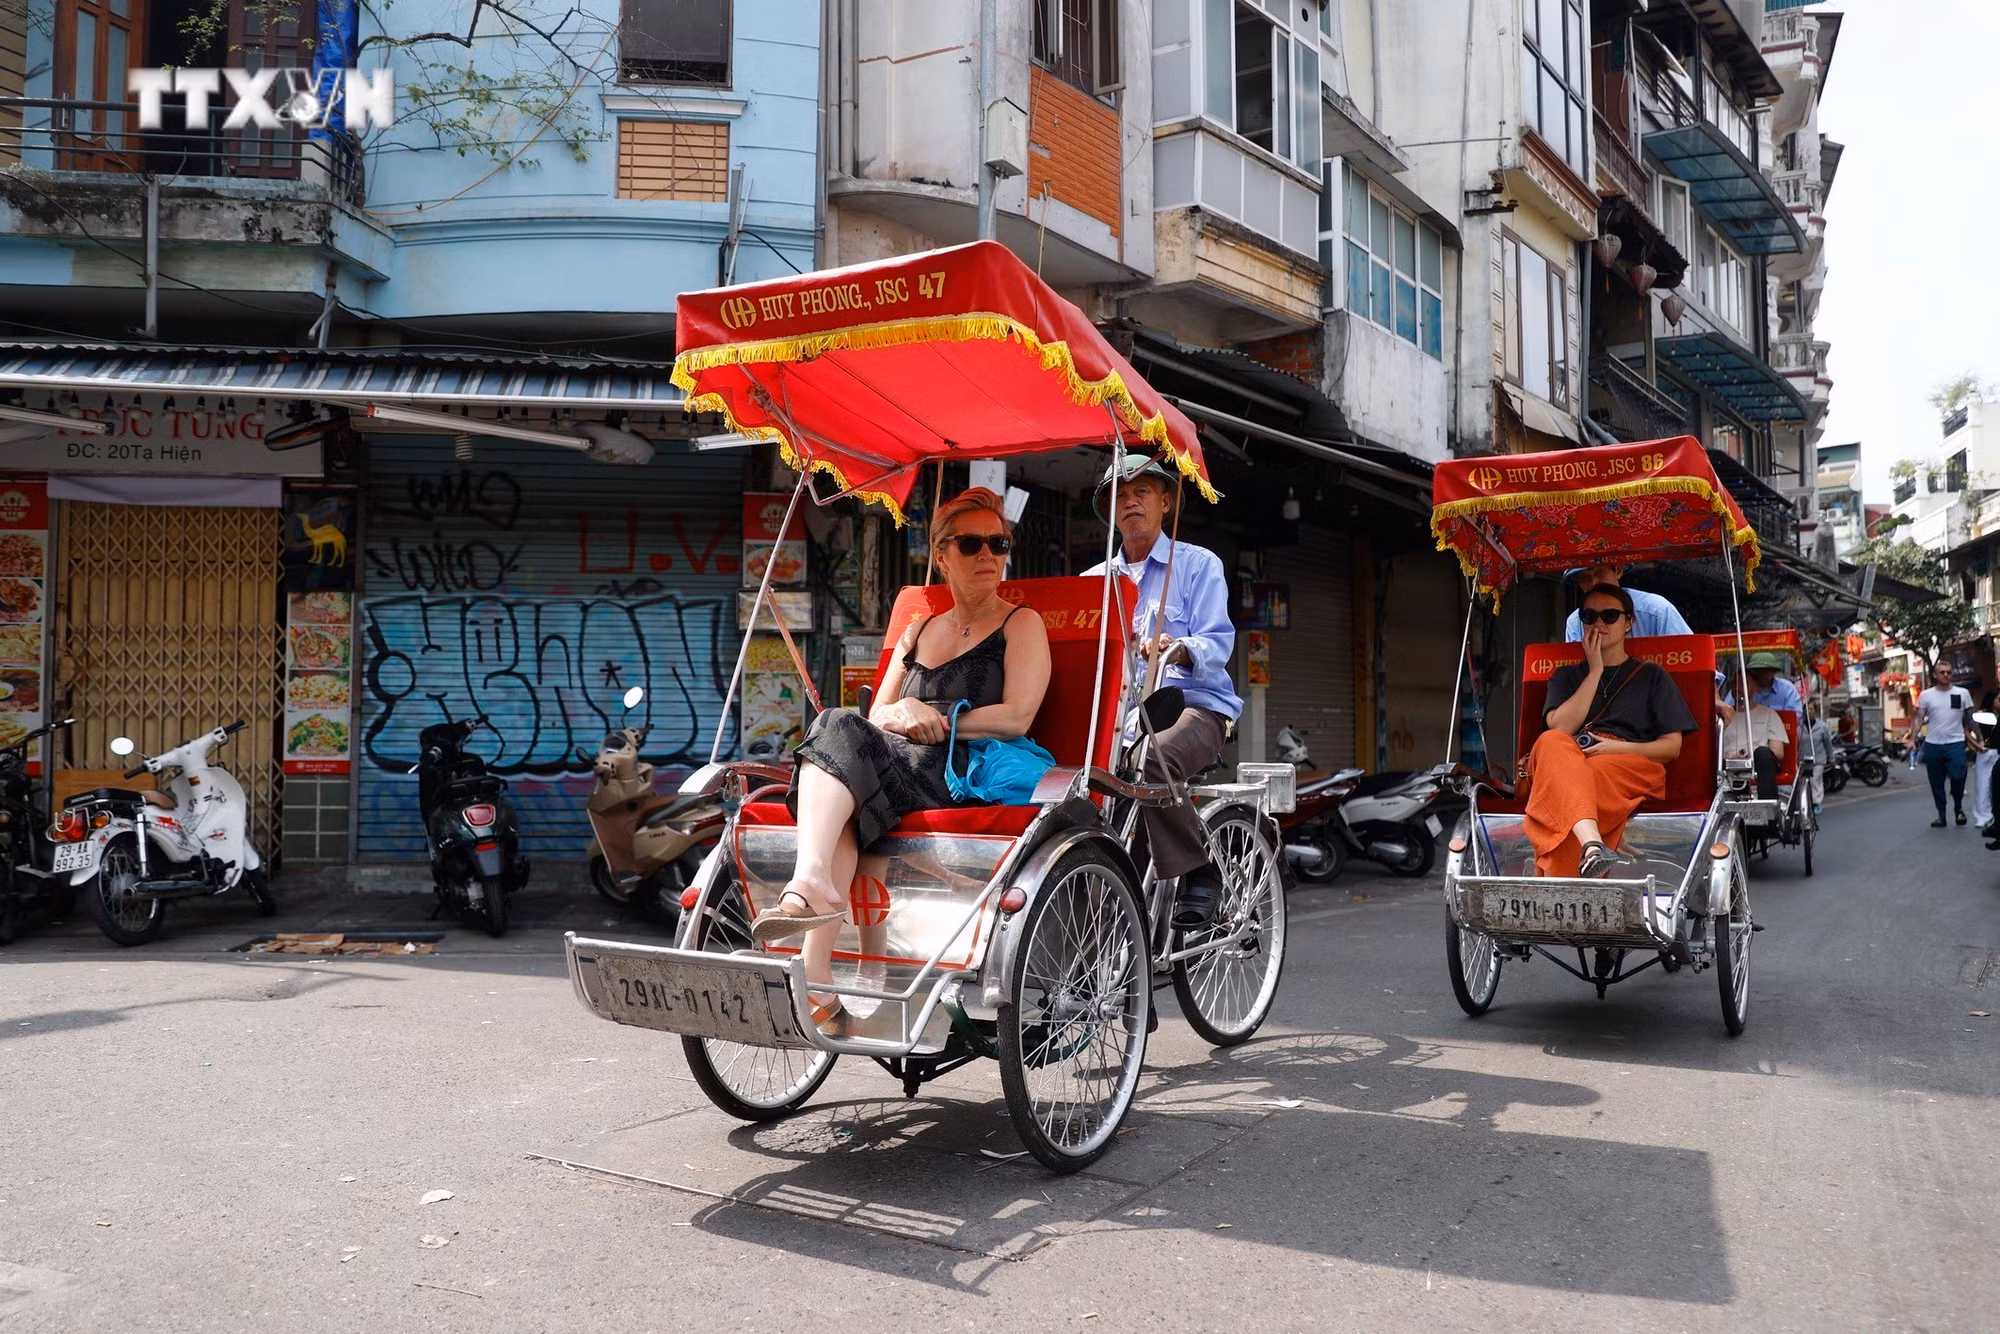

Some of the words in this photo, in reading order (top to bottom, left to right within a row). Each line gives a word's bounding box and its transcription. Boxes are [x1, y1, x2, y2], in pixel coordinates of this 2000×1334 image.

[759, 293, 794, 322] HUY
[875, 277, 909, 305] JSC
[918, 271, 946, 299] 47
[67, 443, 101, 459] ĐC:
[160, 445, 202, 464] Hiện
[1506, 467, 1538, 483] HUY
[1641, 453, 1664, 473] 86
[1073, 609, 1102, 628] 47
[1666, 650, 1693, 666] 86
[60, 842, 88, 858] 29-AA
[55, 854, 91, 871] 992.35
